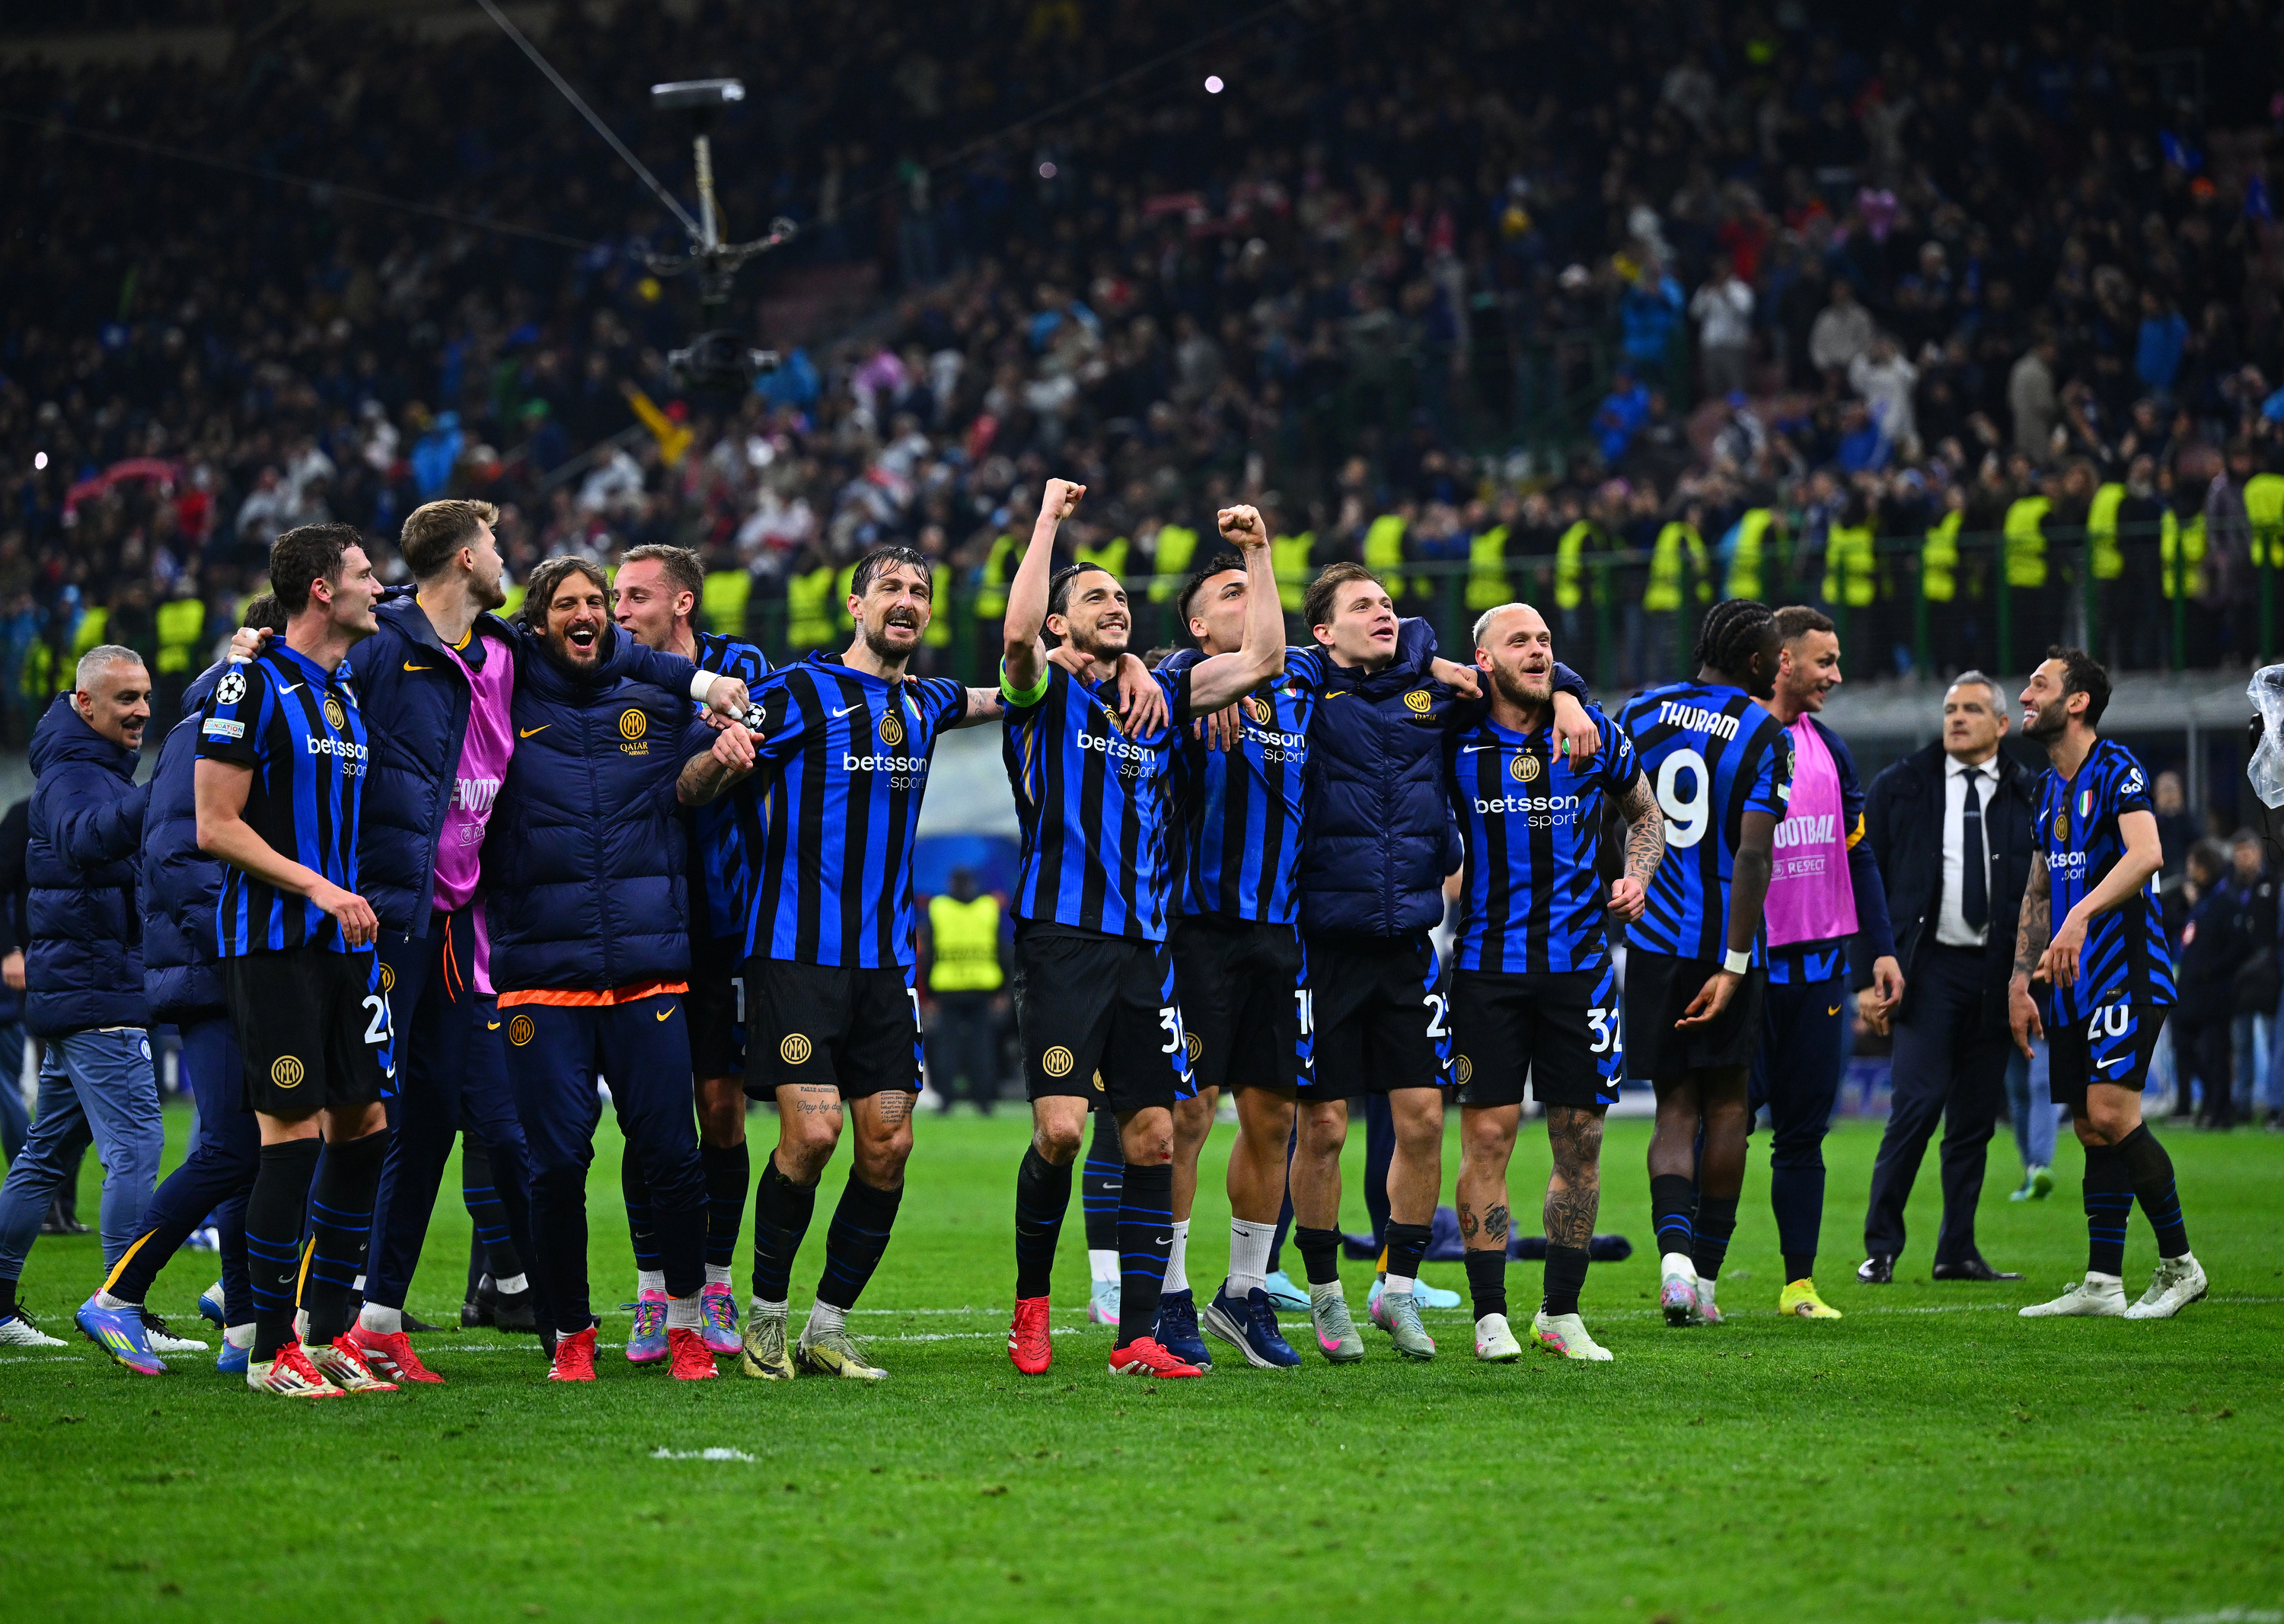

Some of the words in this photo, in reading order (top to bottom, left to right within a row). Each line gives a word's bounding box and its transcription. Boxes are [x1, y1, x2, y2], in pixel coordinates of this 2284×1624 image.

[205, 722, 244, 733] FOUNDATION
[1658, 700, 1740, 741] THURAM
[1217, 724, 1305, 748] etsson
[306, 734, 368, 761] betsson
[620, 742, 649, 753] QATAR
[1261, 749, 1305, 764] .sport
[843, 751, 927, 772] betsson
[1115, 764, 1156, 778] .sport
[1473, 794, 1579, 814] betsson
[1657, 748, 1709, 848] 9
[1523, 811, 1577, 830] .sport
[907, 987, 923, 1033] 1
[1423, 991, 1452, 1038] 2
[1587, 1007, 1622, 1053] 32
[796, 1099, 817, 1114] Day
[819, 1099, 830, 1114] by
